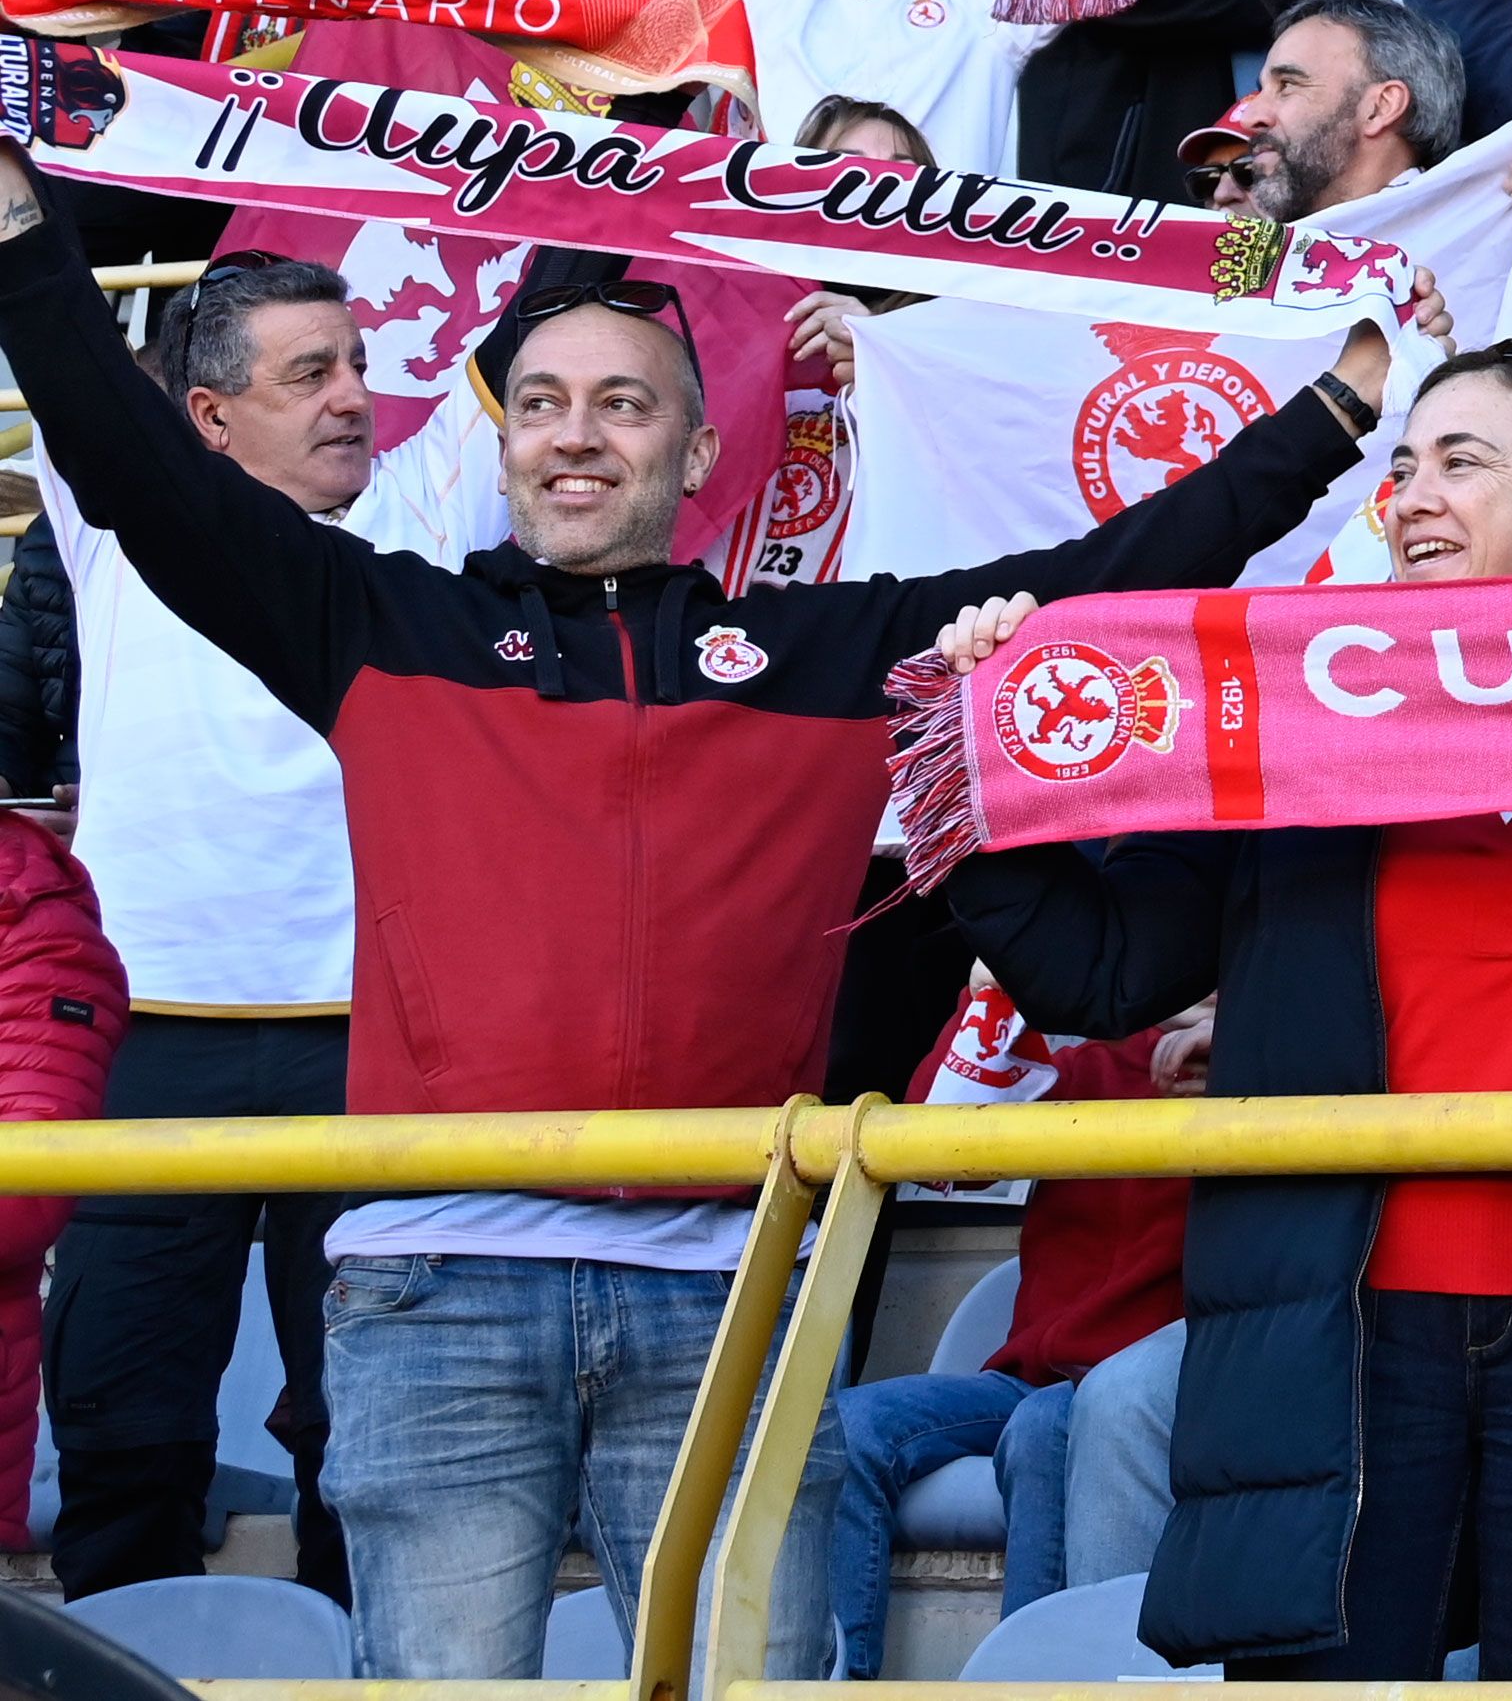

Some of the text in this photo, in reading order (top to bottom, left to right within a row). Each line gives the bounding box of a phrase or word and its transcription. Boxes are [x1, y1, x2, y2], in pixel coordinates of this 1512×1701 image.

[40, 59, 57, 112] PEÑA
[554, 50, 617, 84] CULTURAL
[296, 78, 667, 214] Aupa
[724, 139, 1090, 252] Cultu
[1081, 360, 1268, 501] CULTURAL Y DEPORT
[755, 542, 804, 578] 23
[997, 680, 1026, 758] LEONESA
[1101, 664, 1137, 749] CULTURAL
[1219, 675, 1246, 732] 1923
[942, 1052, 983, 1082] NESA
